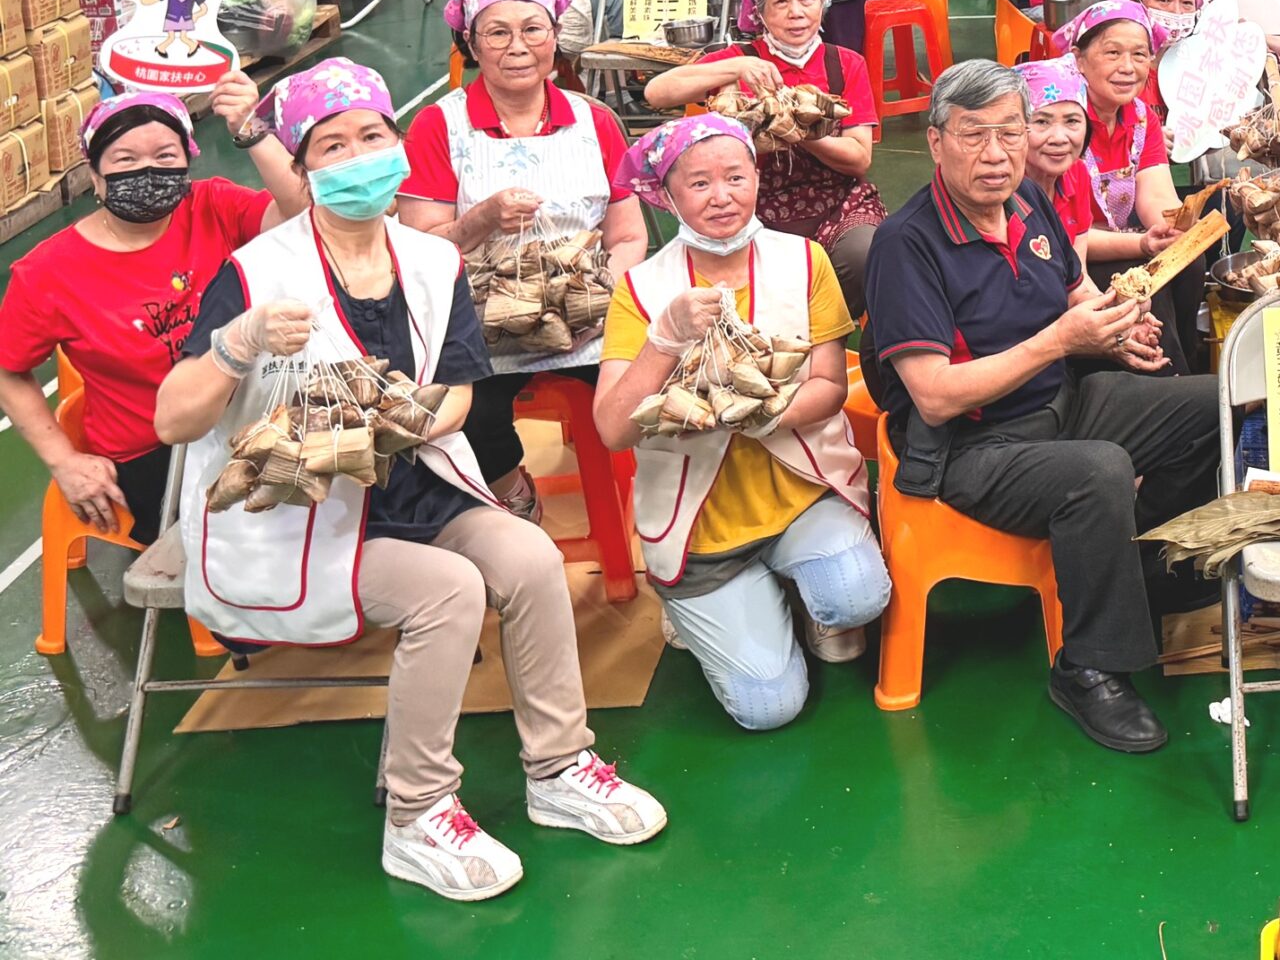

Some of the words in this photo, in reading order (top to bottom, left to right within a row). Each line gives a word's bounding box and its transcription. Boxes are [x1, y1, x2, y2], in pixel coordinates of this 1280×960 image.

[134, 67, 206, 83] 桃園家扶中心
[160, 335, 188, 366] Yo
